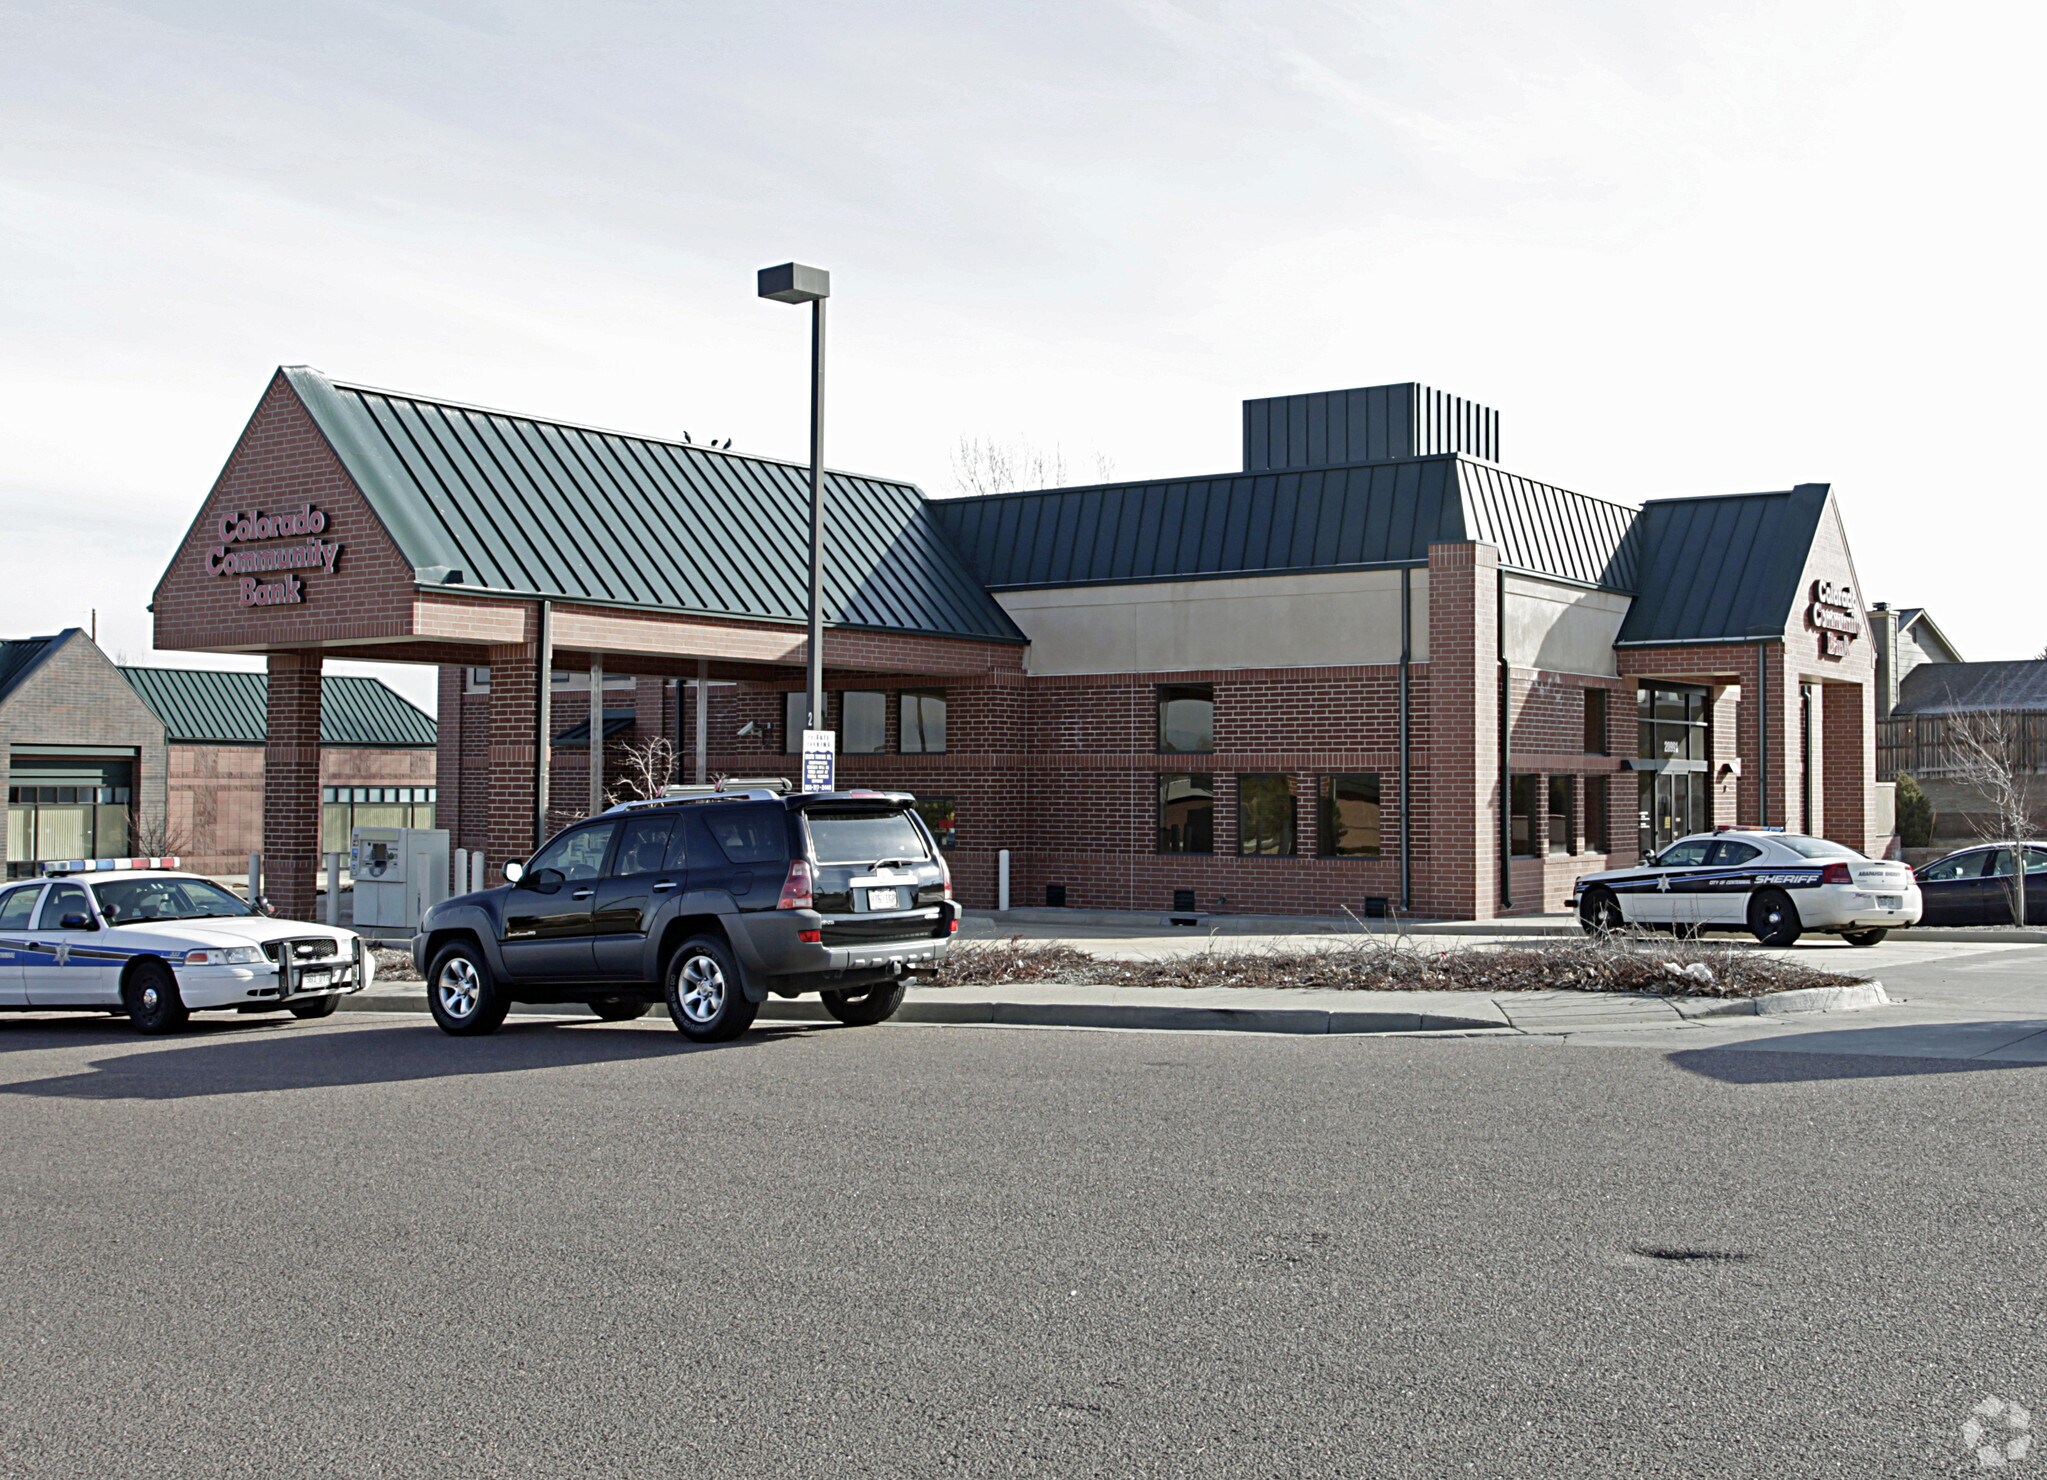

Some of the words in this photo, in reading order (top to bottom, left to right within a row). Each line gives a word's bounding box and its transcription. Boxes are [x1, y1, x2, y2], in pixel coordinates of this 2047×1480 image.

[218, 503, 326, 543] Colorado
[205, 537, 339, 577] Community
[239, 574, 302, 607] Bank
[808, 711, 813, 726] 2
[1754, 875, 1819, 884] SHERIFF
